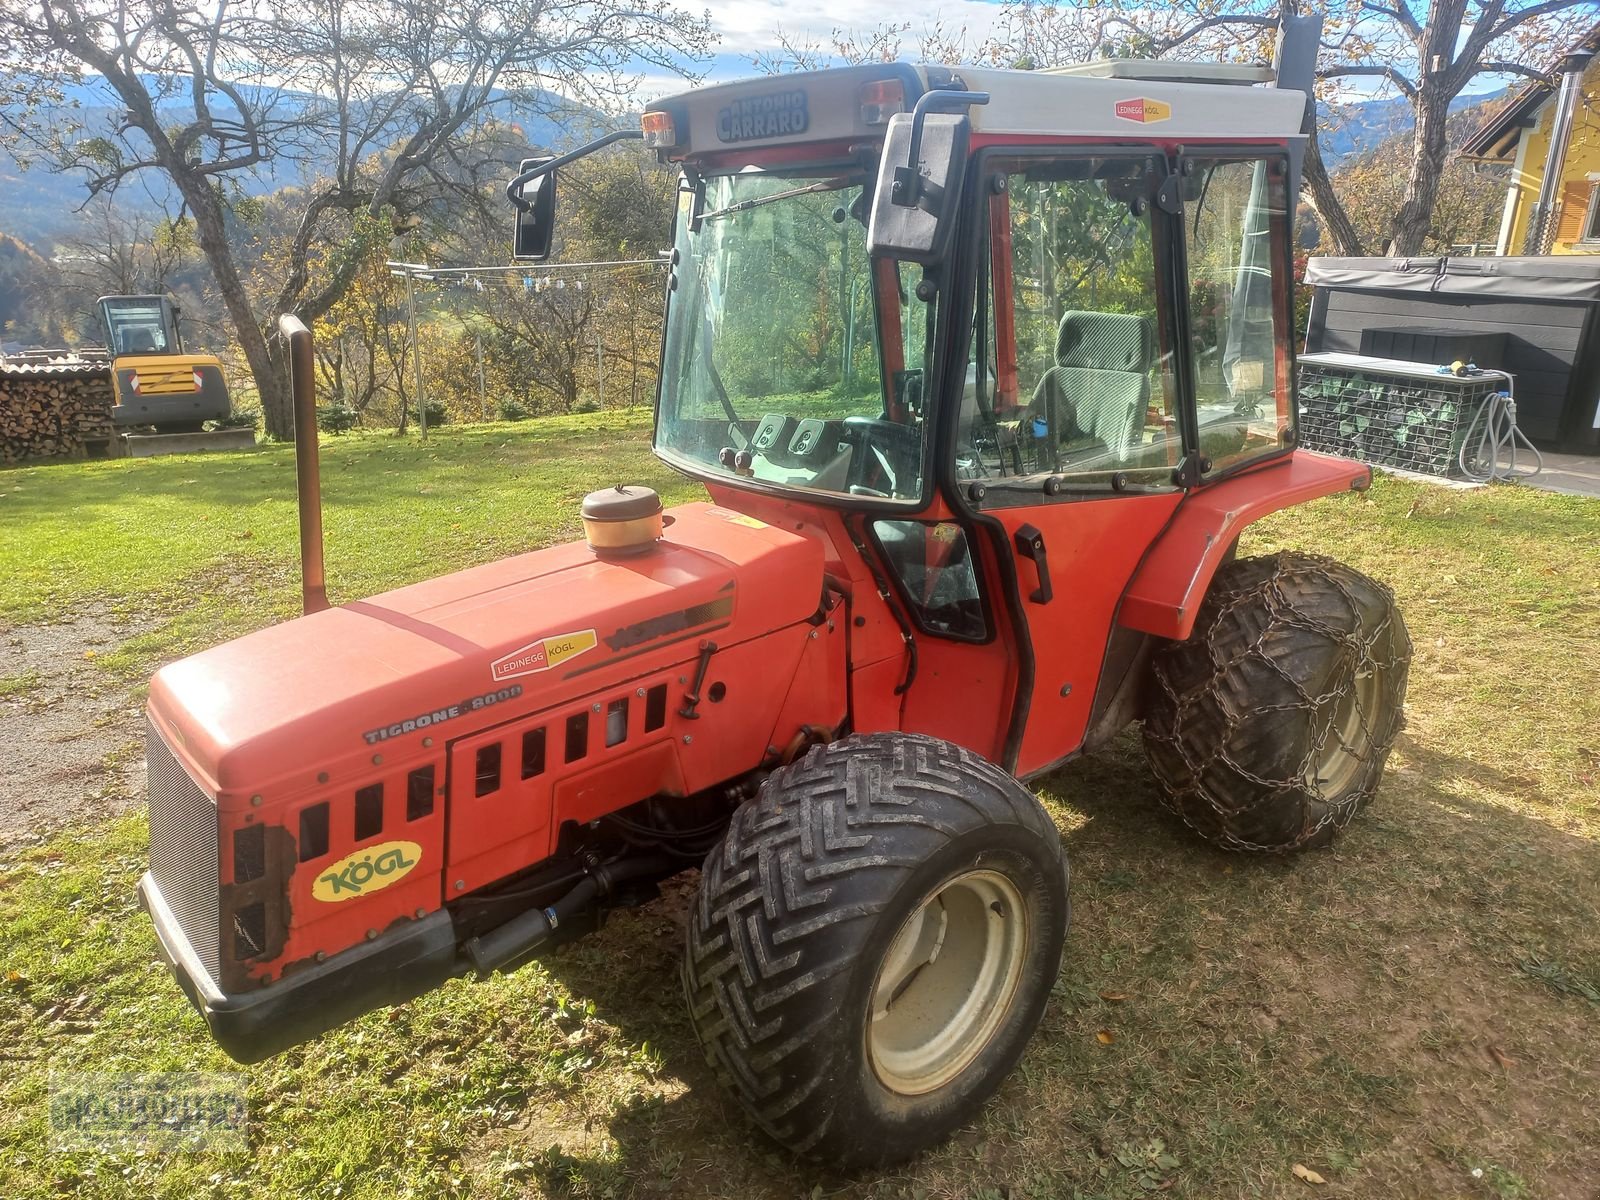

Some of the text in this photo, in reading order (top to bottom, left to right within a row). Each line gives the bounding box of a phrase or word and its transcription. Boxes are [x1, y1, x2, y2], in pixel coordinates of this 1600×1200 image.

[731, 92, 805, 115] ANTONIO
[1117, 106, 1143, 114] LEDINEGG
[718, 108, 806, 140] CARRARO
[496, 641, 575, 675] LEDINEGG KÖGL
[364, 705, 460, 744] TIGRONE
[320, 848, 415, 894] KÖGL
